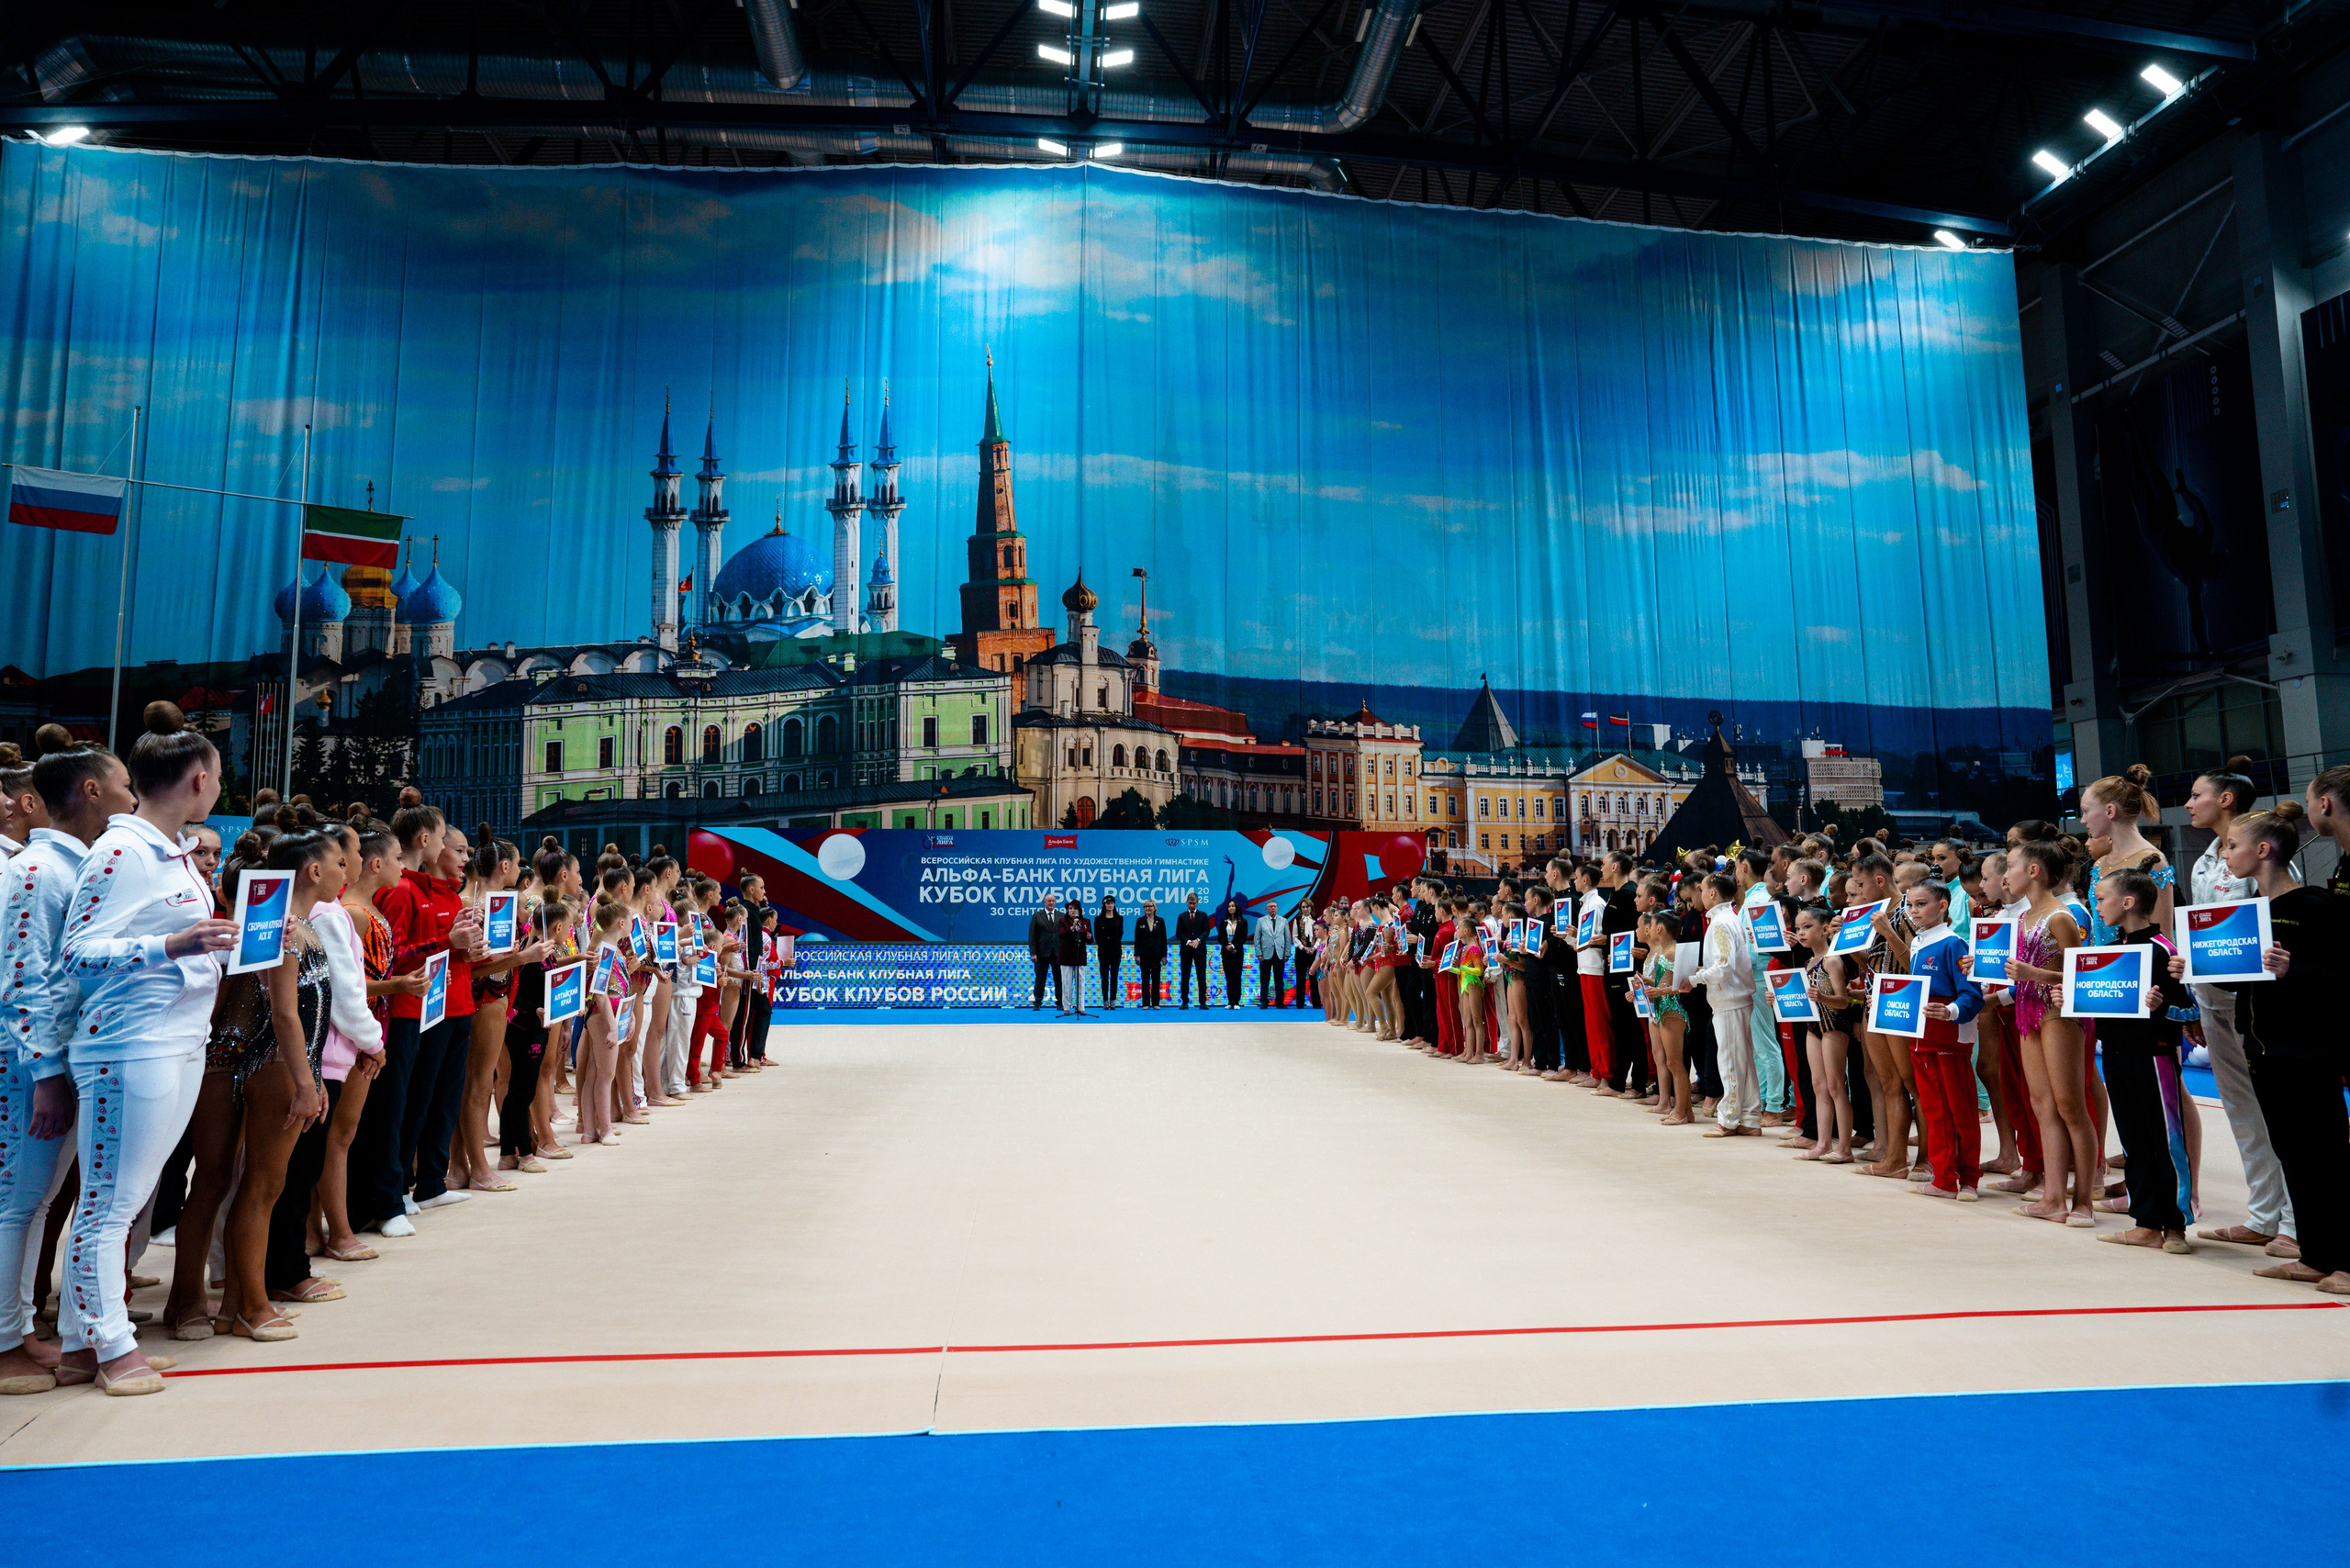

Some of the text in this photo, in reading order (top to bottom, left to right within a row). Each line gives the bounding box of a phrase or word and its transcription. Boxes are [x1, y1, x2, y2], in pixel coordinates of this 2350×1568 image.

[921, 856, 992, 865] ВСЕРОССИЙСКАЯ
[1073, 857, 1153, 866] ХУДОЖЕСТВЕННОЙ
[1061, 868, 1152, 883] КЛУБНАЯ
[1158, 868, 1209, 883] ЛИГА
[2214, 884, 2230, 893] RUS
[919, 886, 1194, 904] КУБОК КЛУБОВ РОССИИ
[990, 907, 1005, 916] 30
[247, 920, 269, 932] СБОРНАЯ
[1754, 924, 1778, 933] РЕСПУБЛИКА
[1843, 924, 1872, 935] ПЕНЗЕНСКАЯ
[1757, 931, 1779, 940] МОРДОВИЯ
[1845, 931, 1865, 941] ОБЛАСТЬ
[2192, 936, 2258, 949] НИЖЕГОРОДСКАЯ
[795, 949, 872, 961] РОССИЙСКАЯ
[876, 952, 928, 961] КЛУБНАЯ
[931, 952, 960, 962] ЛИГА
[964, 952, 980, 961] ПО
[1975, 948, 2010, 957] НОВОСИБИРСКАЯ
[2208, 947, 2242, 957] ОБЛАСТЬ
[779, 969, 972, 980] ЛЬФА-БАНК КЛУБНАЯ ЛИГА
[2076, 980, 2138, 989] НОВГОРОДСКАЯ
[554, 986, 578, 1002] АЛТАЙСКИЙ
[773, 986, 839, 1002] КУБОК
[844, 986, 925, 1002] КЛУБОВ
[931, 986, 1007, 1002] РОССИИ
[560, 997, 572, 1007] КРАЙ
[1887, 1000, 1910, 1009] ОМСКАЯ
[1884, 1009, 1910, 1019] ОБЛАСТЬ
